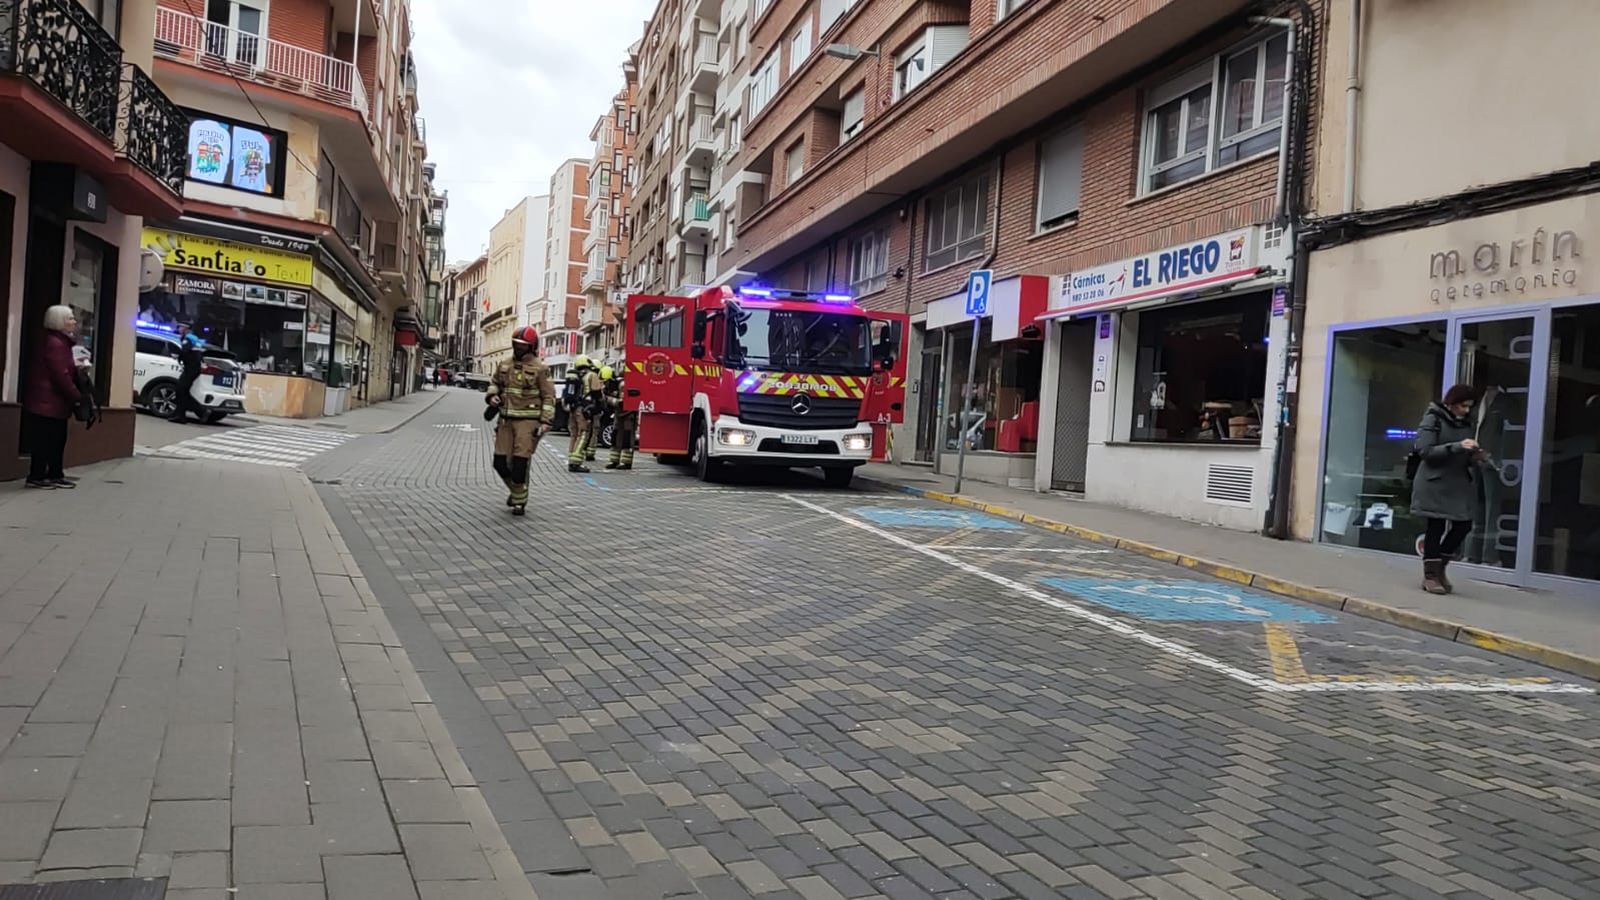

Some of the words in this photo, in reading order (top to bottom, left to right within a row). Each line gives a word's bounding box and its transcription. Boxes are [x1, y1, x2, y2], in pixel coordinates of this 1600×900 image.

[260, 235, 284, 247] Desde
[174, 249, 266, 277] Santiago
[1132, 258, 1152, 289] EL
[1158, 240, 1220, 285] RIEGO
[177, 278, 216, 291] ZAMORA
[1072, 273, 1106, 290] Cárnicas
[970, 275, 985, 311] P
[222, 377, 232, 385] 112
[640, 400, 655, 411] A-3
